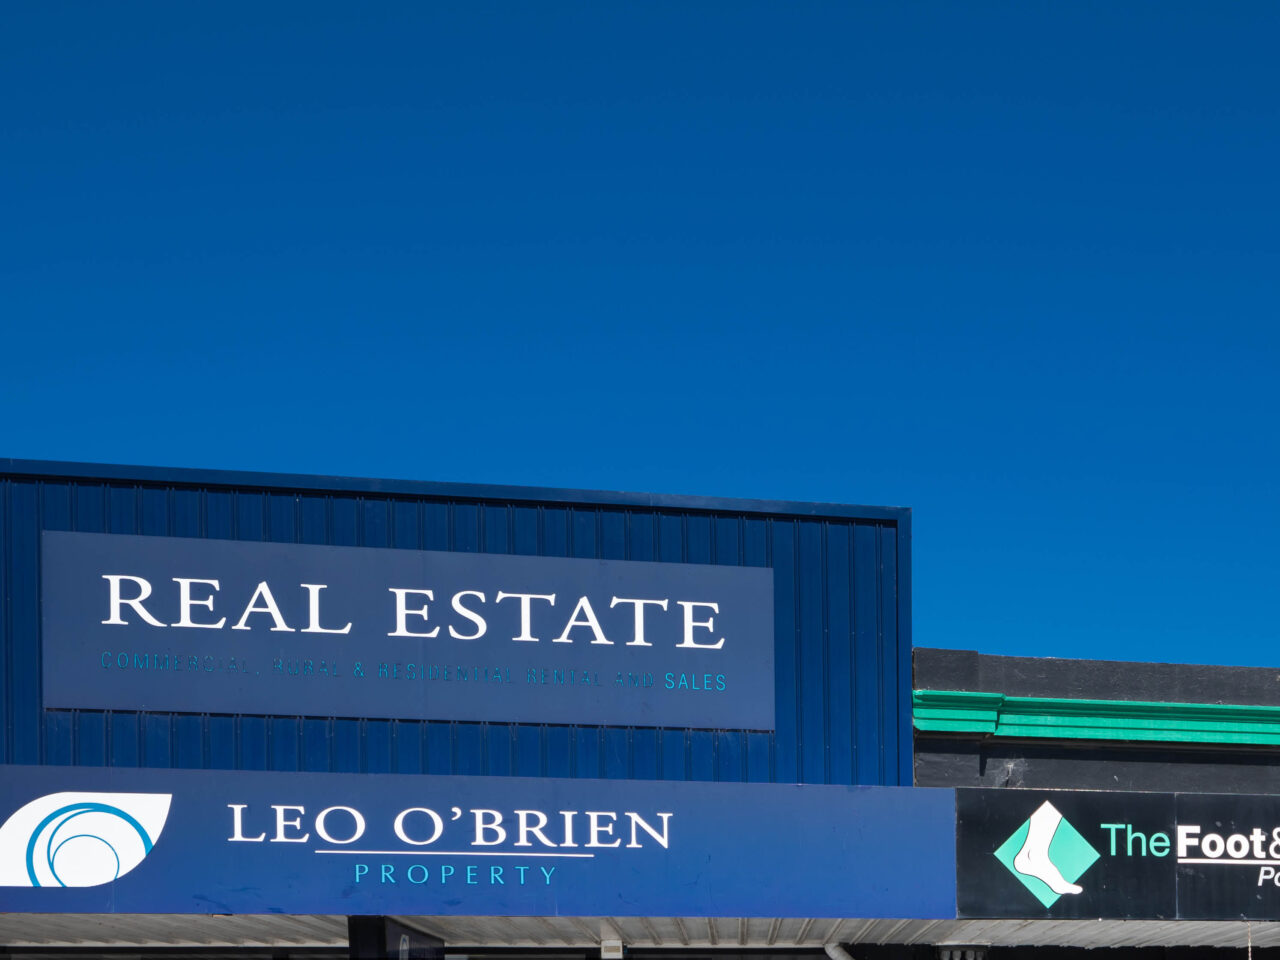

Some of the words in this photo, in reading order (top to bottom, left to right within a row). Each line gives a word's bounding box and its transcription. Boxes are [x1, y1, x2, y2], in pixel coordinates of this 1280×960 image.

[101, 575, 352, 634] REAL
[388, 588, 725, 650] ESTATE
[353, 661, 365, 678] &
[664, 672, 727, 691] SALES
[227, 803, 366, 845] LEO
[393, 806, 673, 849] O'BRIEN
[1101, 823, 1170, 858] The
[355, 863, 556, 885] PROPERTY
